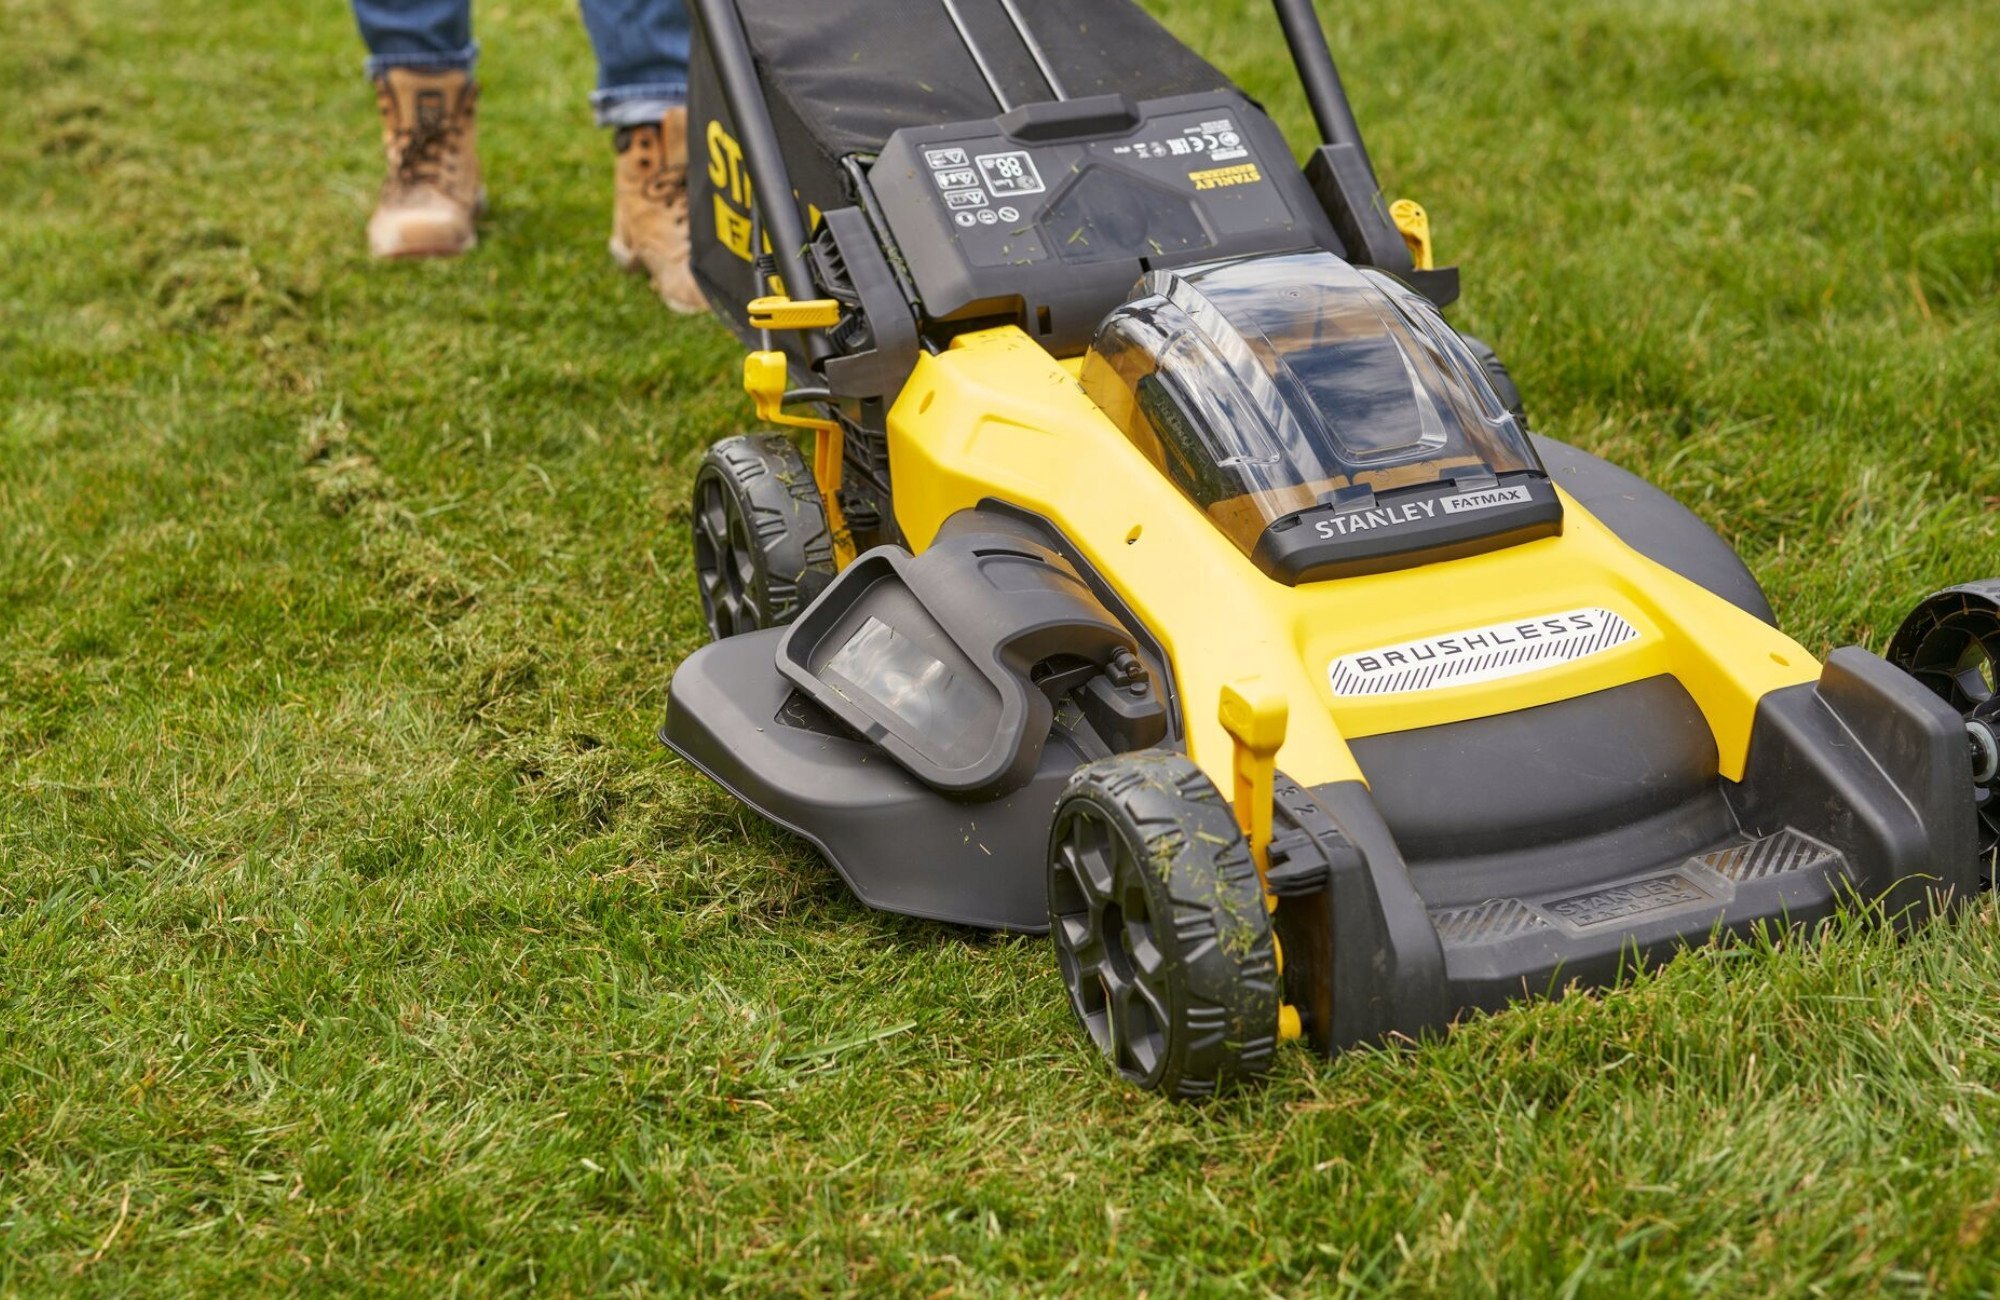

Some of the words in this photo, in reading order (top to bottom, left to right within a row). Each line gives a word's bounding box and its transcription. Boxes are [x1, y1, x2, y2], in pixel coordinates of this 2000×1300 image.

[1195, 171, 1261, 190] STANLEY
[1314, 499, 1437, 540] STANLEY
[1451, 488, 1522, 510] FATMAX
[1355, 613, 1595, 673] BRUSHLESS
[1554, 877, 1682, 917] STANLEY
